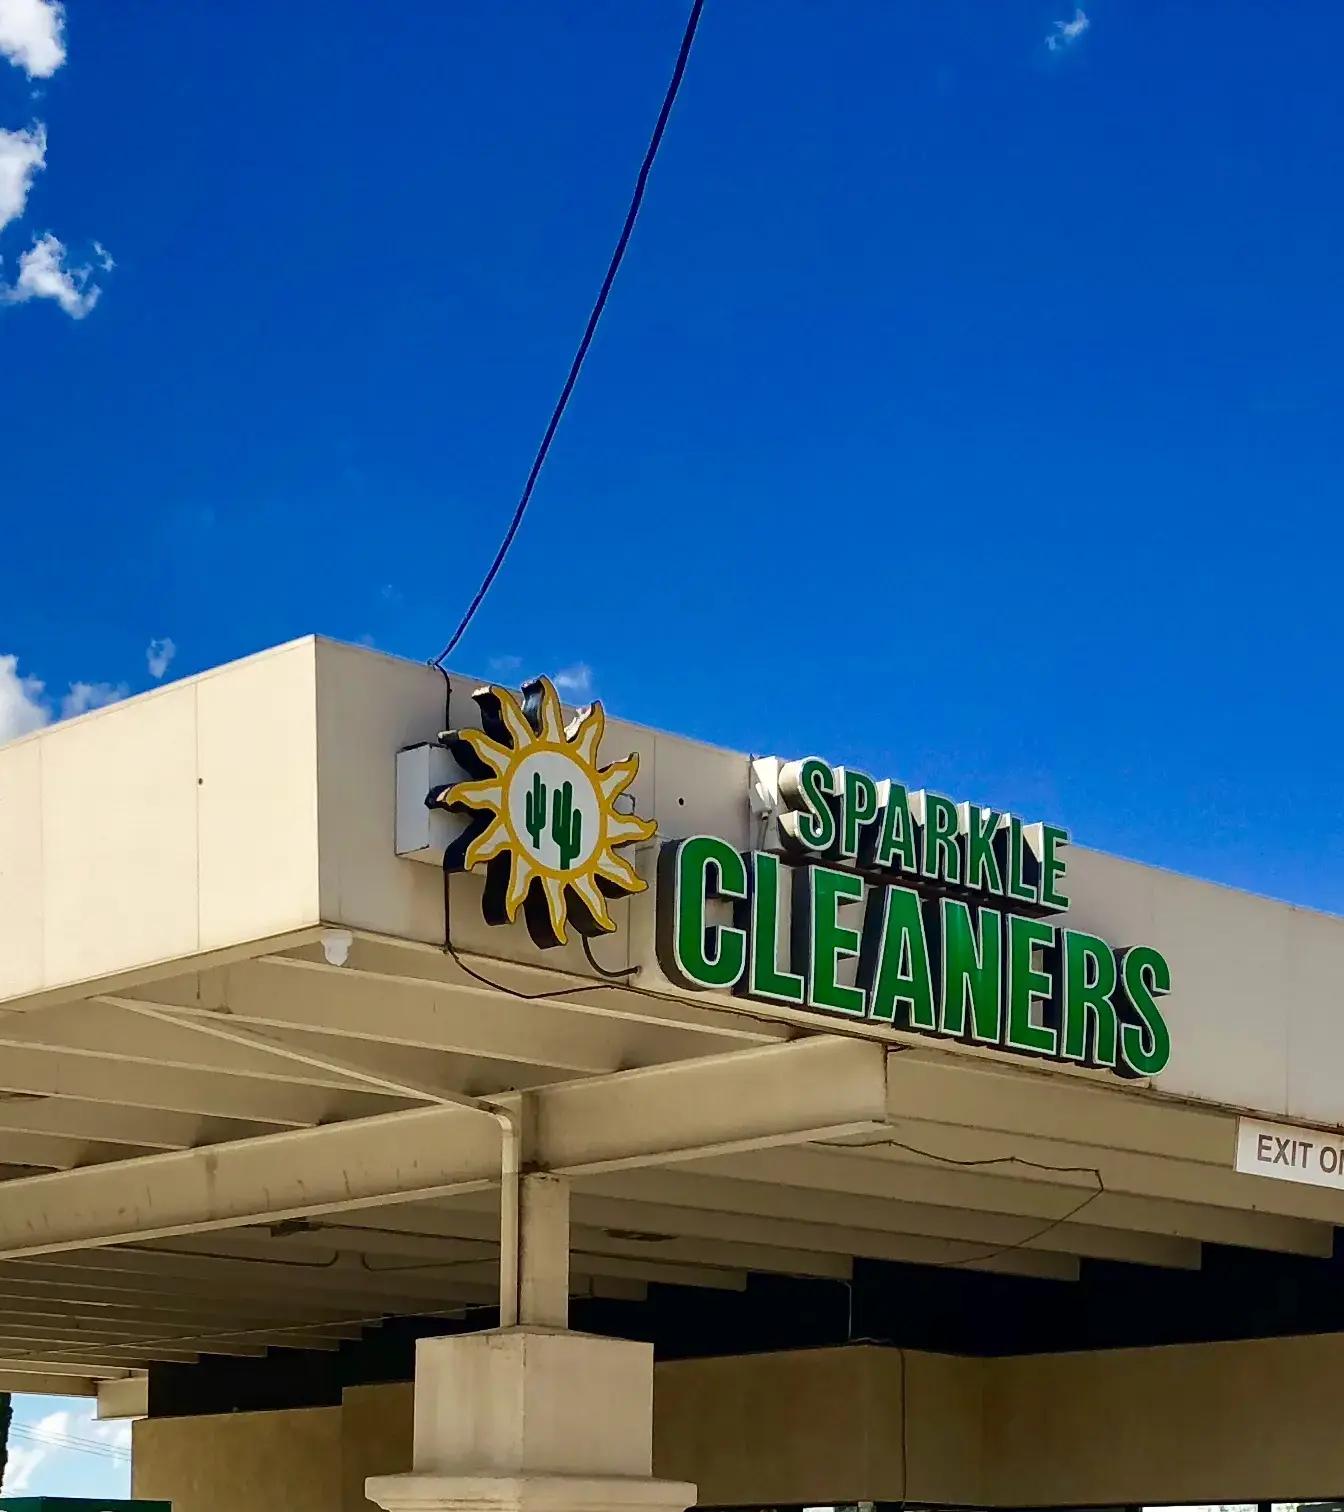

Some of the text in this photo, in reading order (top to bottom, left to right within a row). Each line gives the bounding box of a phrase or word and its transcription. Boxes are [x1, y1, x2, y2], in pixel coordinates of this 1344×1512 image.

[794, 756, 1070, 913] SPARKLE
[666, 835, 1172, 1077] CLEANERS
[1257, 1133, 1314, 1169] EXIT
